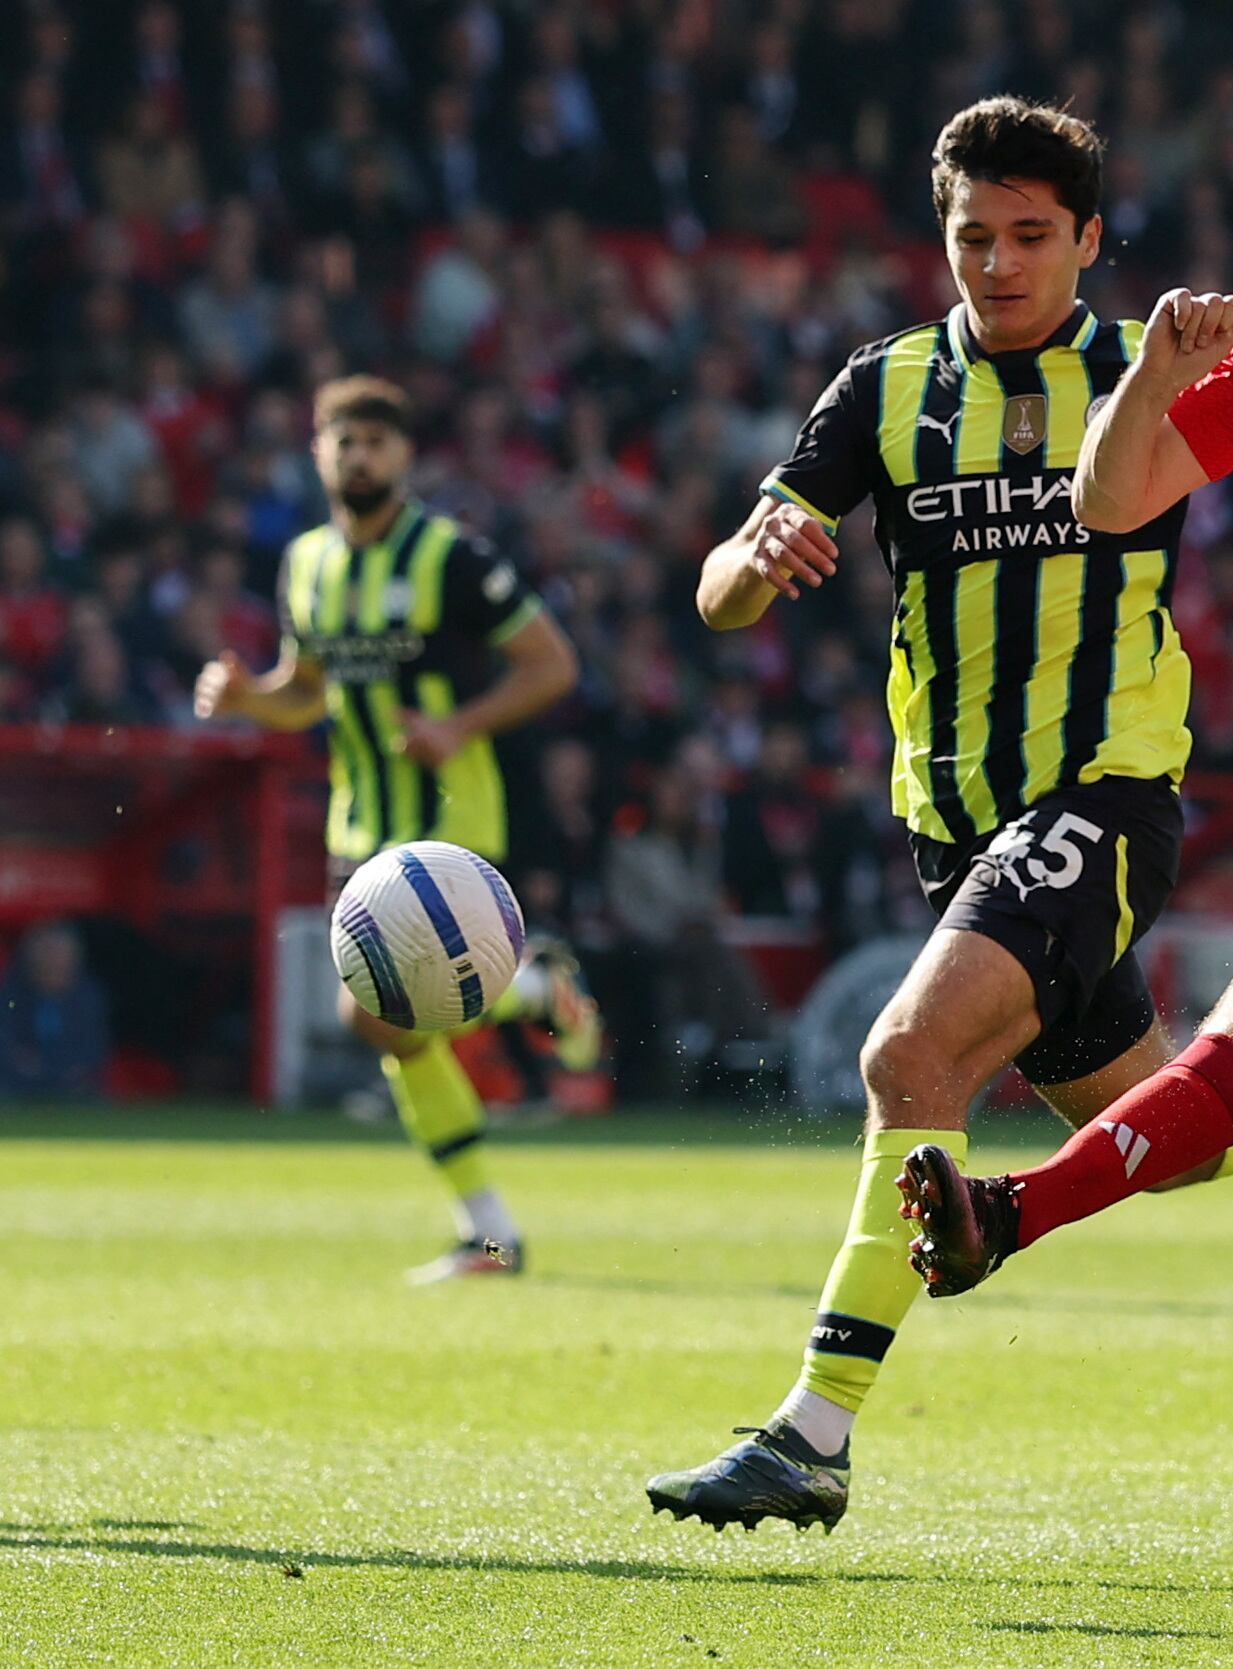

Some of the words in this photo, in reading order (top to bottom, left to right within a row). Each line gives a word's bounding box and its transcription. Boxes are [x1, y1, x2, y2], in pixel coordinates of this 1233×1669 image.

[1013, 431, 1034, 440] FIFA
[907, 474, 1073, 522] ETIHA
[952, 522, 1091, 552] AIRWAYS
